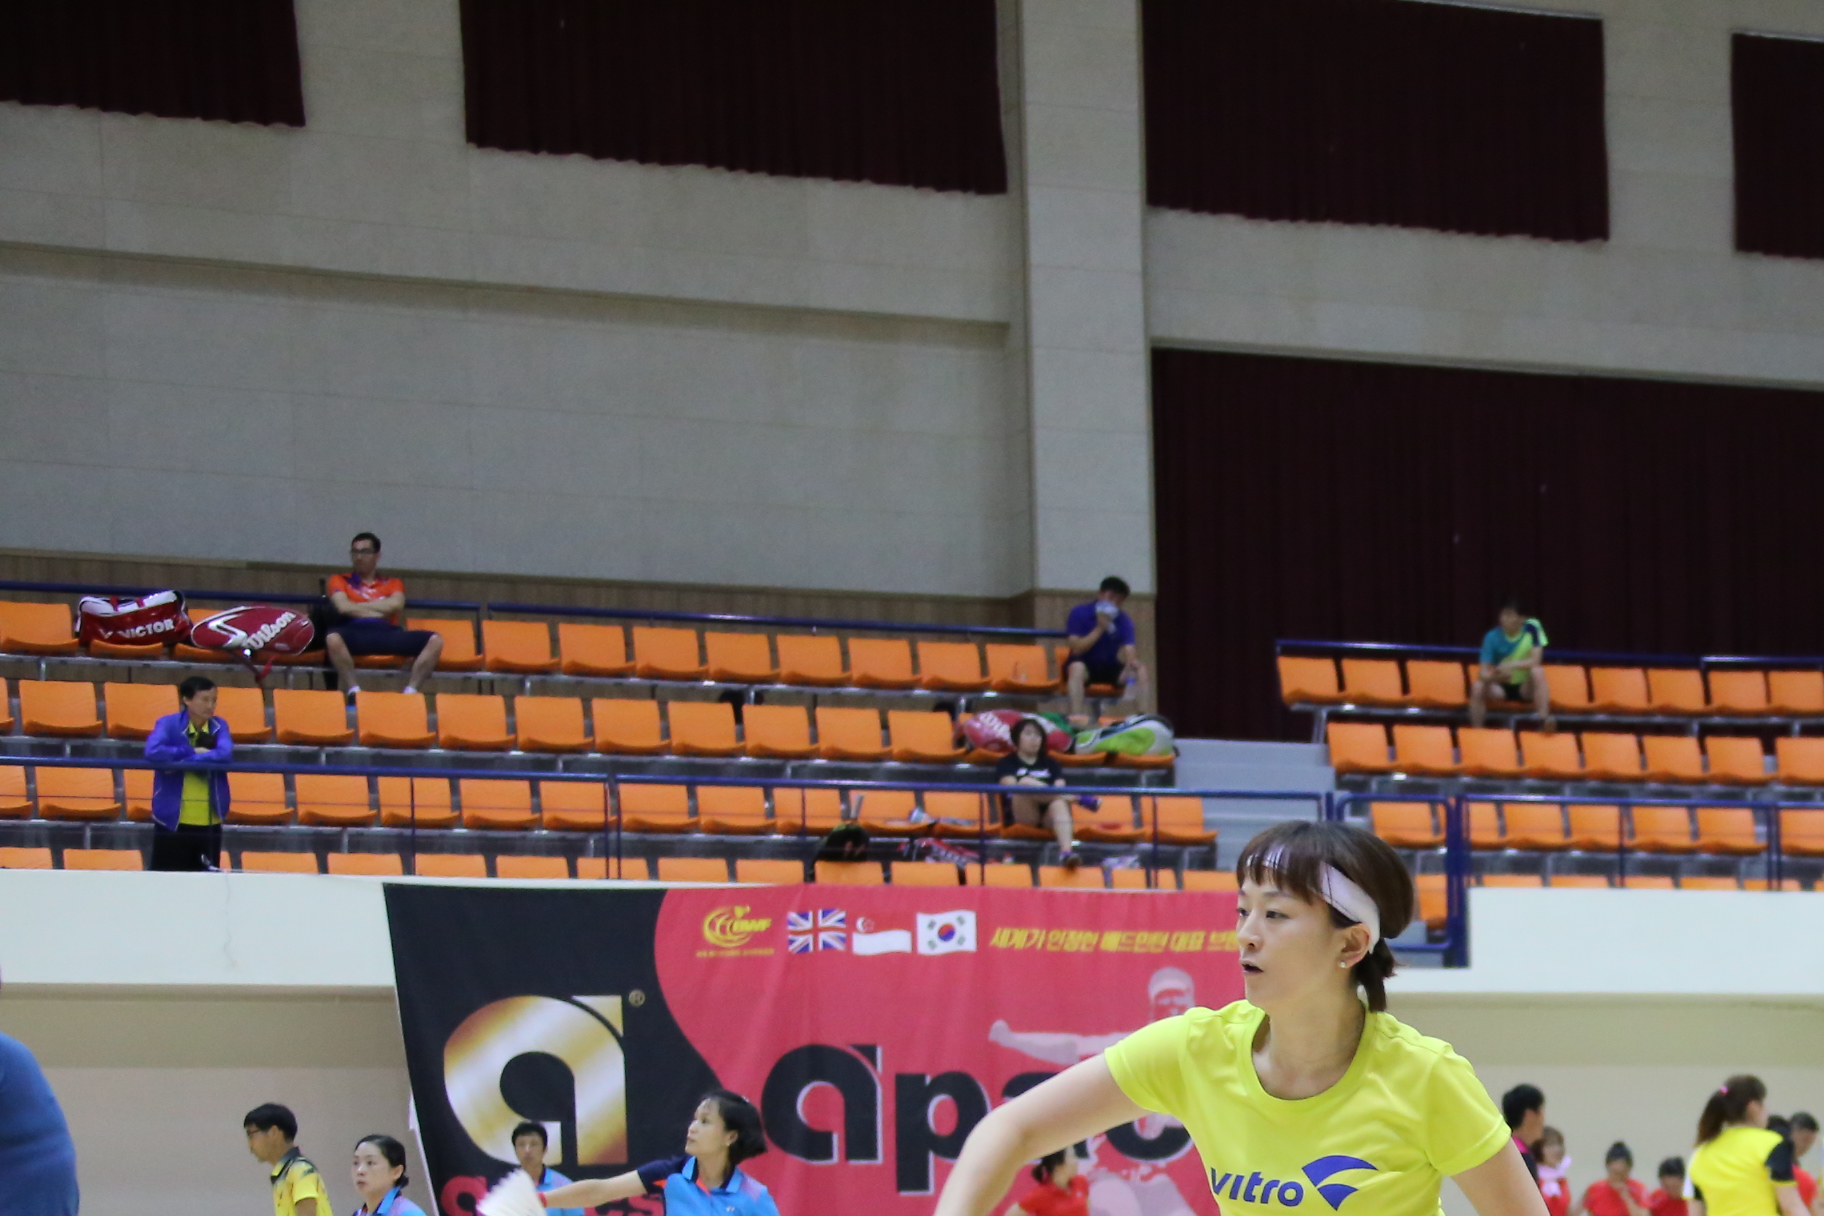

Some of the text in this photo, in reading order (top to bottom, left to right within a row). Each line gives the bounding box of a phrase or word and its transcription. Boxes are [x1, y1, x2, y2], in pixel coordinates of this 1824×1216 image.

[117, 618, 175, 639] VICTOR
[242, 611, 297, 650] Wilson
[989, 927, 1046, 949] 세계가
[1210, 1157, 1304, 1207] vitro
